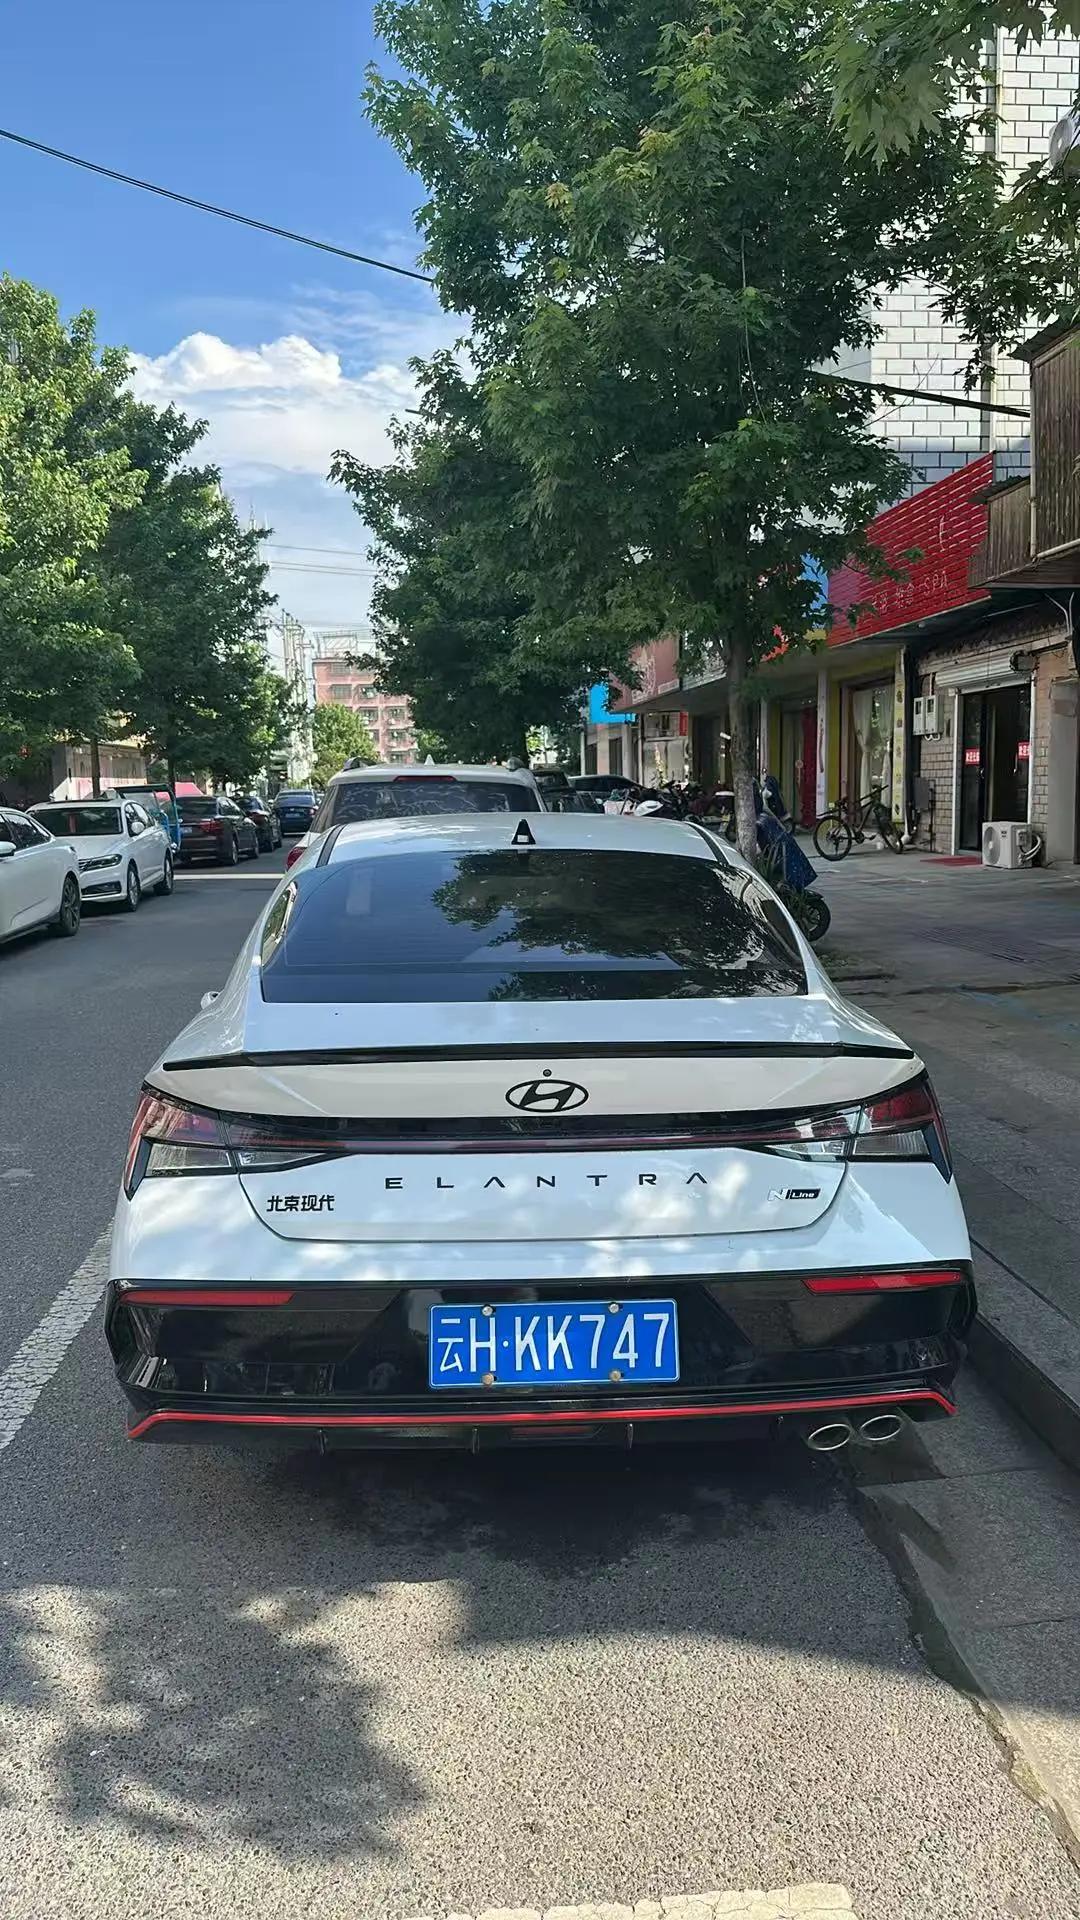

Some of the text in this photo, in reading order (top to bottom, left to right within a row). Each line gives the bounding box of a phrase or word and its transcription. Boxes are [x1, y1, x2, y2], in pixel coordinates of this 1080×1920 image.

[385, 1172, 708, 1189] ELANTRA
[266, 1194, 335, 1212] 北京现代
[791, 1191, 817, 1199] Line
[437, 1313, 670, 1373] 云H·KK747
